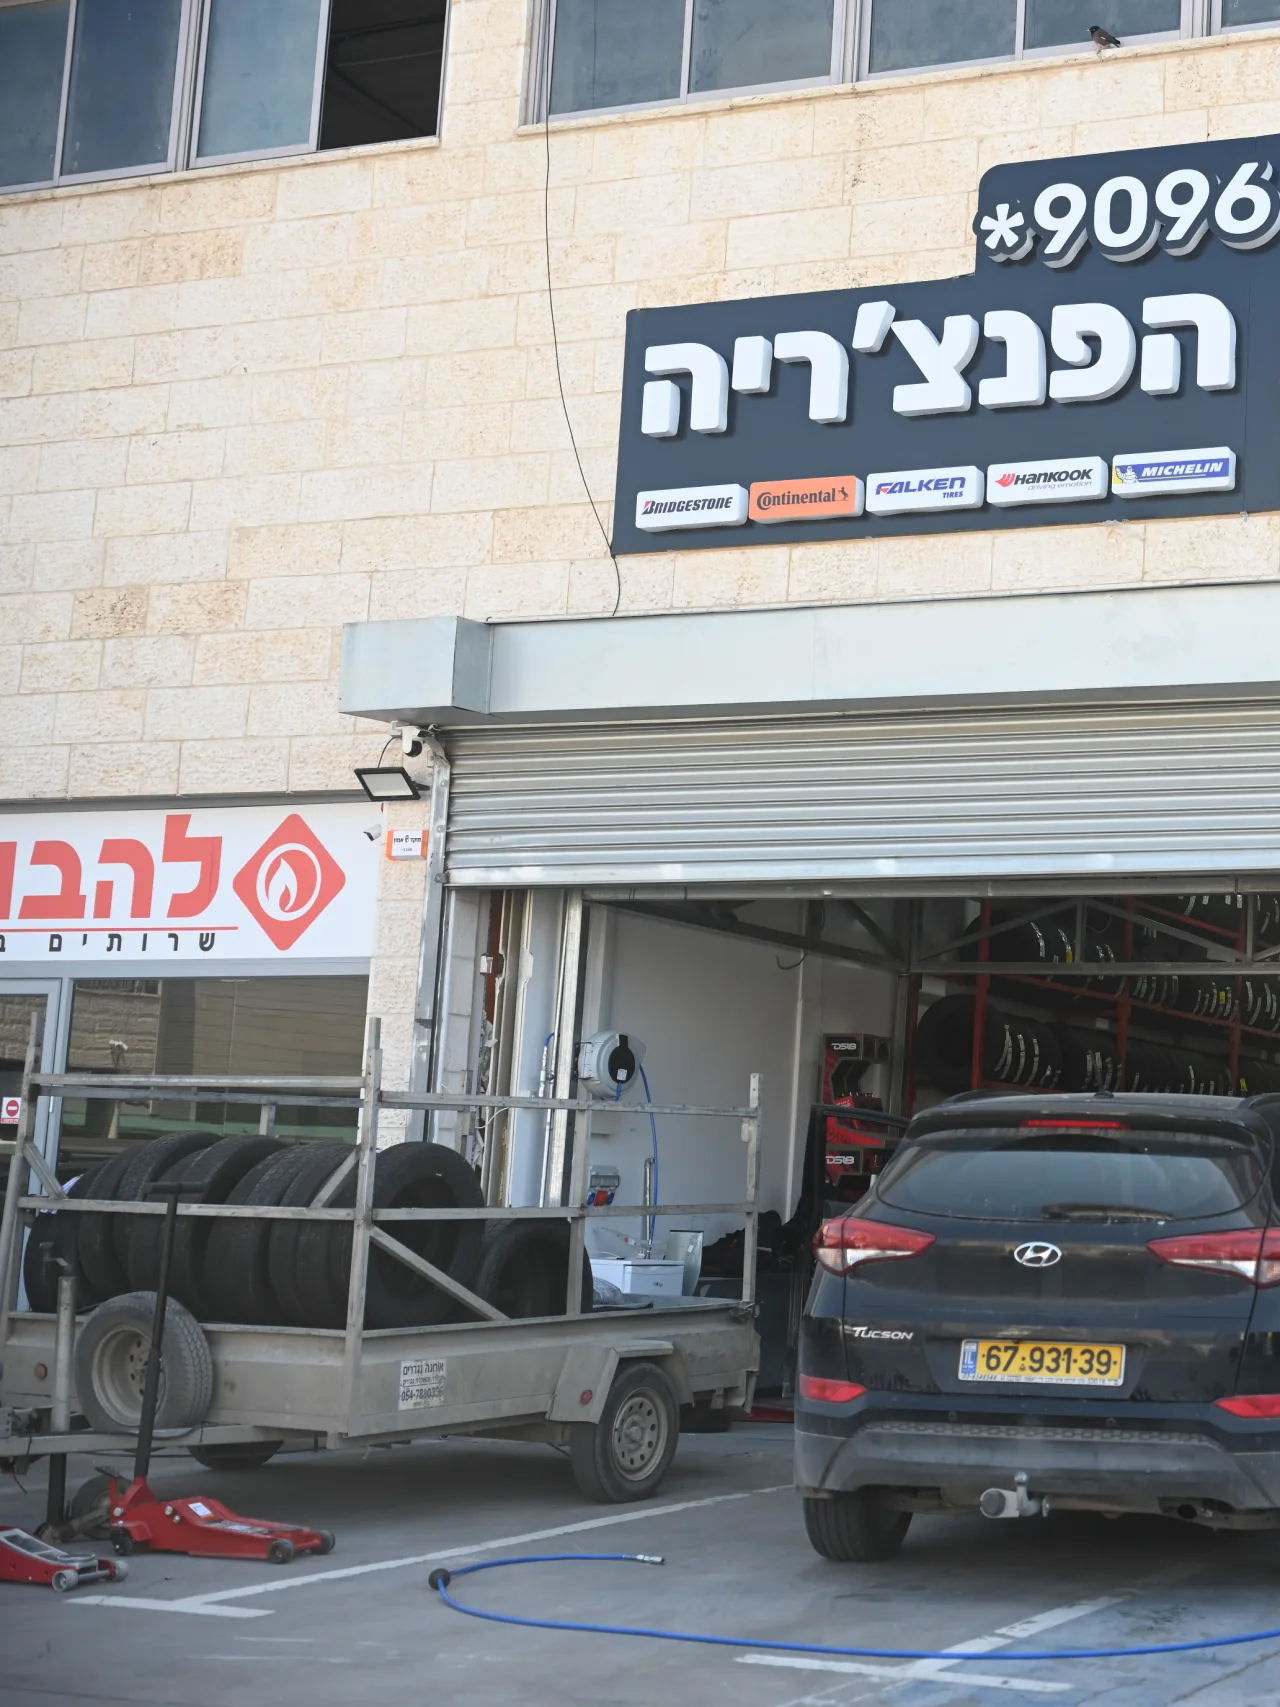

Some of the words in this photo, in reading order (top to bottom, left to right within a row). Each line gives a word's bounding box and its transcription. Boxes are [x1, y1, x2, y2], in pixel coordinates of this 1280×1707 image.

[641, 293, 1237, 438] הפנצ'ריה
[1013, 467, 1094, 488] HANKOOK
[1140, 461, 1223, 478] MICHELIN
[874, 476, 967, 497] FALKEN
[941, 491, 965, 500] TIRES
[1028, 482, 1057, 491] driving
[1059, 480, 1093, 489] emotion
[642, 496, 734, 516] BRIDGESTONE
[756, 487, 838, 512] Continental
[48, 932, 215, 952] שרותים
[963, 1351, 974, 1365] IL
